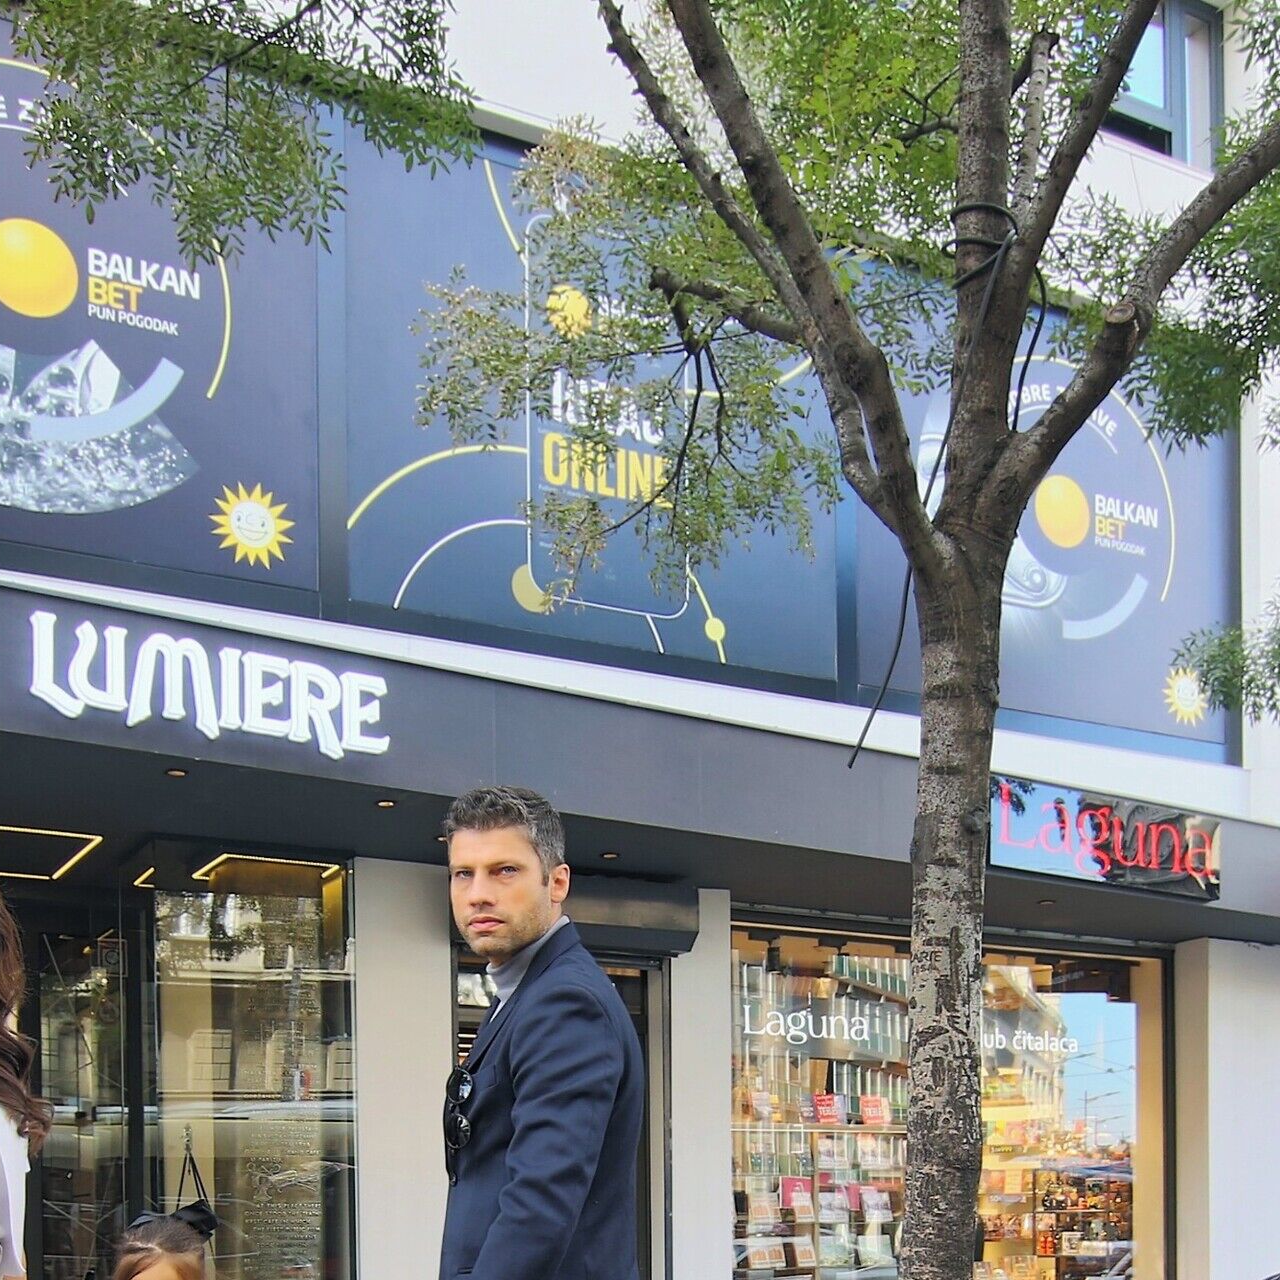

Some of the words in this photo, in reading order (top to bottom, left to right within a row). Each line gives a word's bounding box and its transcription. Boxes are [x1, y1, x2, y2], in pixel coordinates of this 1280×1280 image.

[88, 247, 201, 300] BALKAN
[88, 276, 143, 313] BET
[88, 304, 116, 323] PUN
[118, 308, 179, 336] POGODAK
[543, 432, 674, 509] ONLINE
[1095, 493, 1158, 529] BALKAN
[1095, 515, 1125, 541] BET
[30, 610, 390, 760] LUMIERE
[998, 783, 1217, 880] Laguna
[743, 1004, 870, 1044] Laguna
[1012, 1030, 1079, 1054] čitalaca
